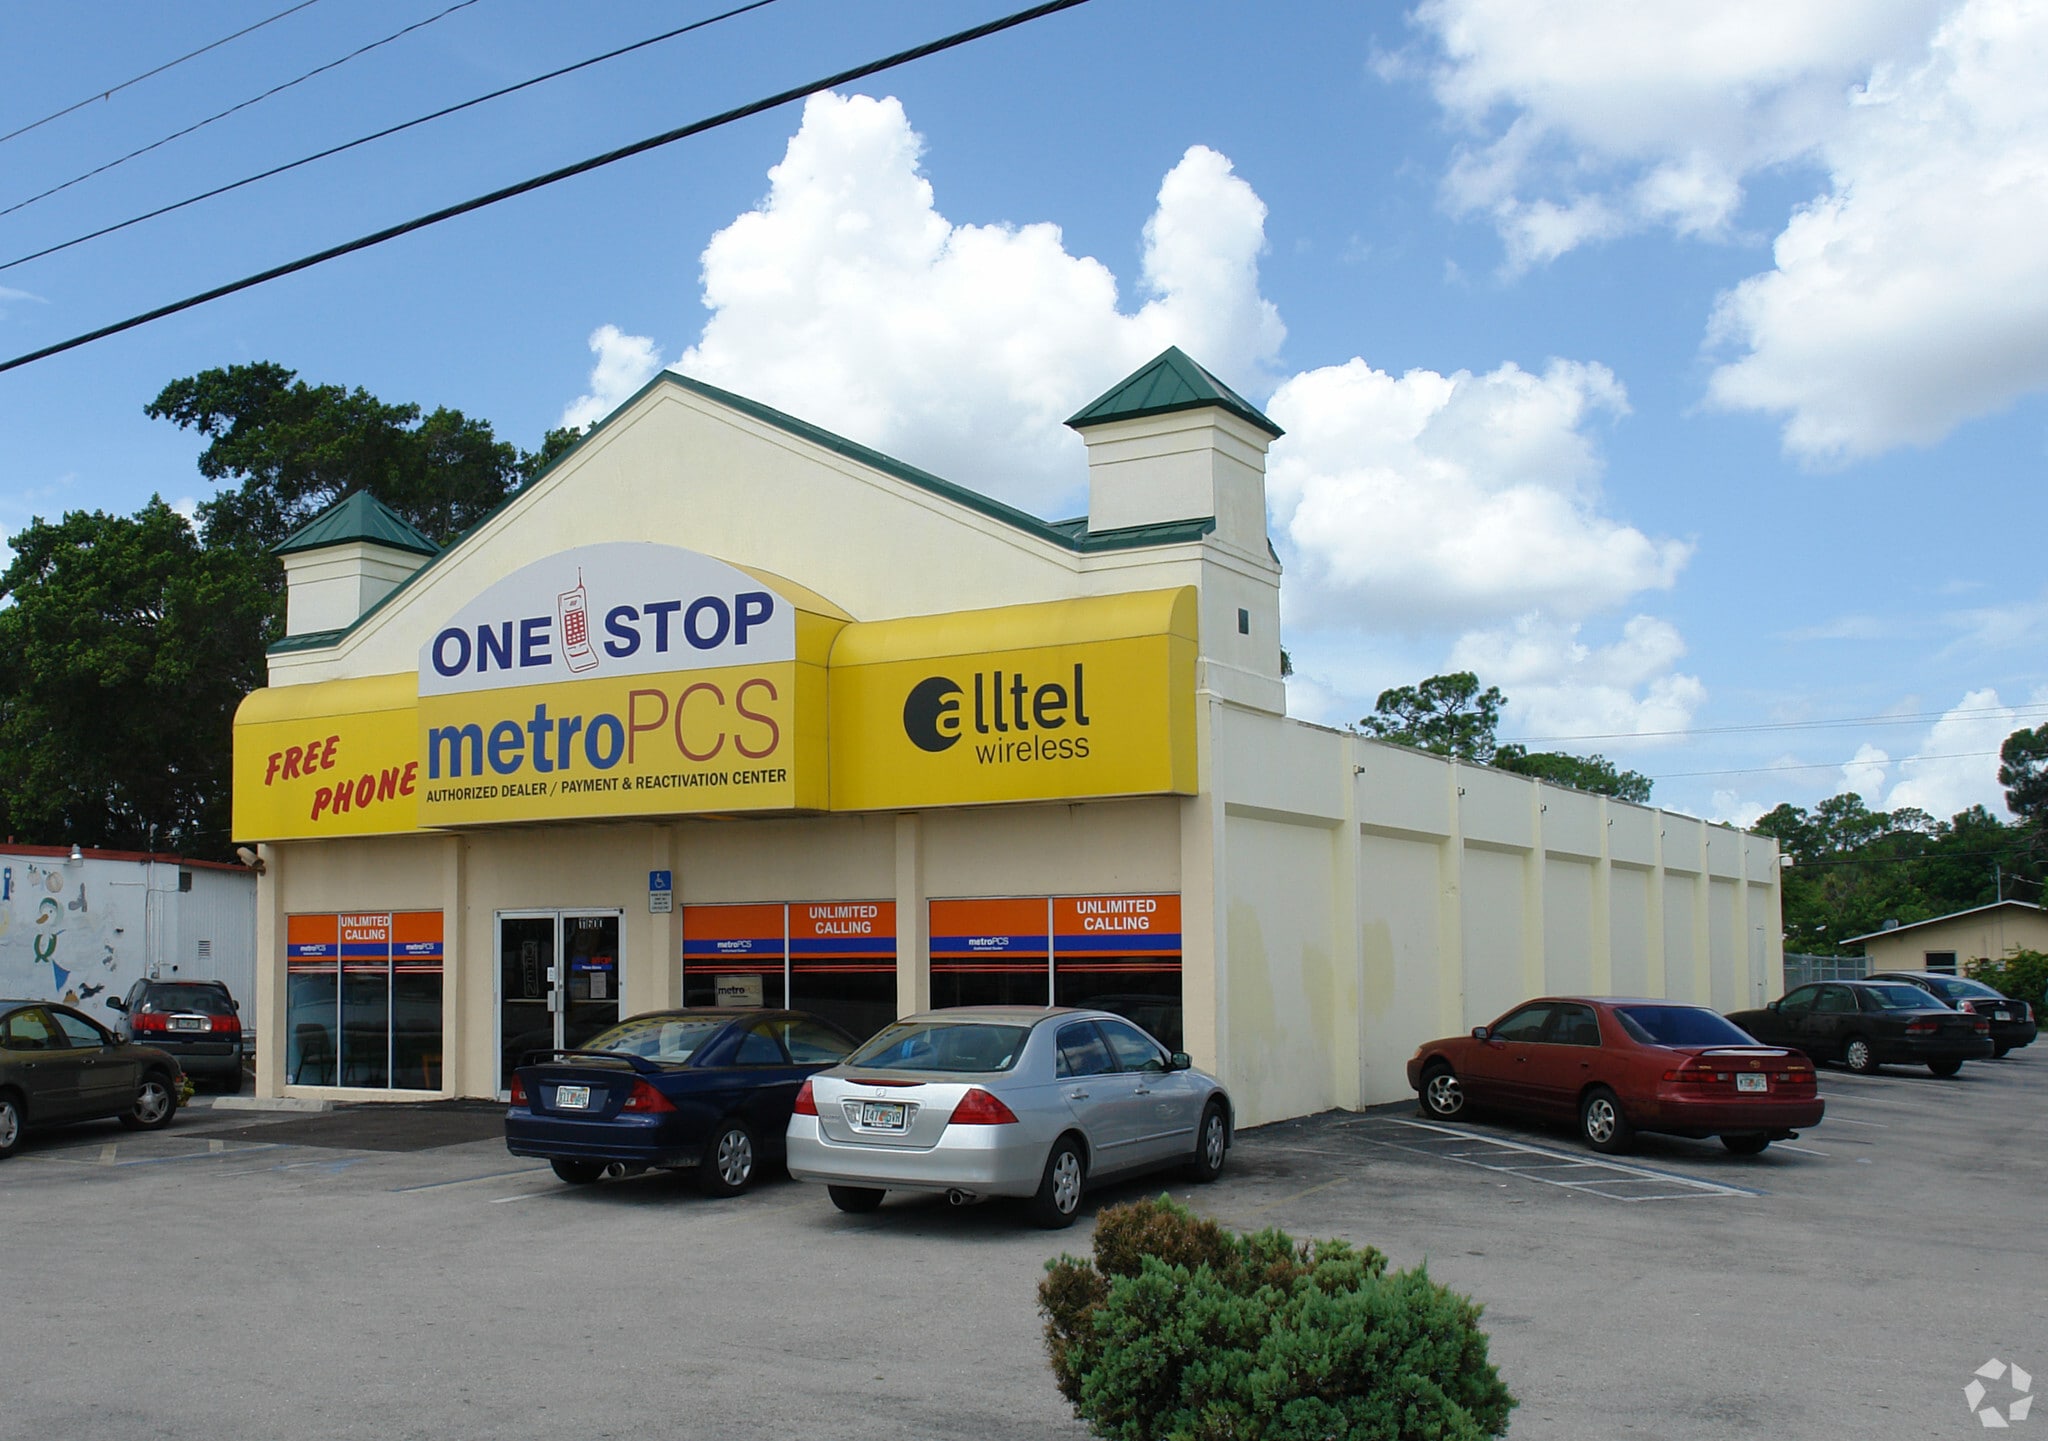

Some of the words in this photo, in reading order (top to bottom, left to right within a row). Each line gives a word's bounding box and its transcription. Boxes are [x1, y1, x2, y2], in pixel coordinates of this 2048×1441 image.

[432, 616, 552, 677] ONE
[603, 591, 774, 658] STOP
[903, 663, 1090, 752] alltel
[427, 678, 780, 779] metroPCS
[975, 734, 1090, 764] wireless
[264, 735, 341, 786] FREE
[310, 761, 419, 821] PHONE
[426, 785, 498, 803] AUTHORIZED
[501, 782, 548, 797] DEALER
[561, 777, 619, 793] PAYMENT
[622, 776, 632, 790] &
[635, 771, 728, 789] REACTIVATION
[732, 768, 787, 784] CENTER
[809, 905, 878, 919] UNLIMITED
[1076, 899, 1157, 914] UNLIMITED
[341, 915, 390, 927] UNLIMITED
[815, 921, 872, 935] CALLING
[1083, 916, 1150, 930] CALLING
[344, 929, 386, 940] CALLING
[968, 936, 1009, 946] metroPCS
